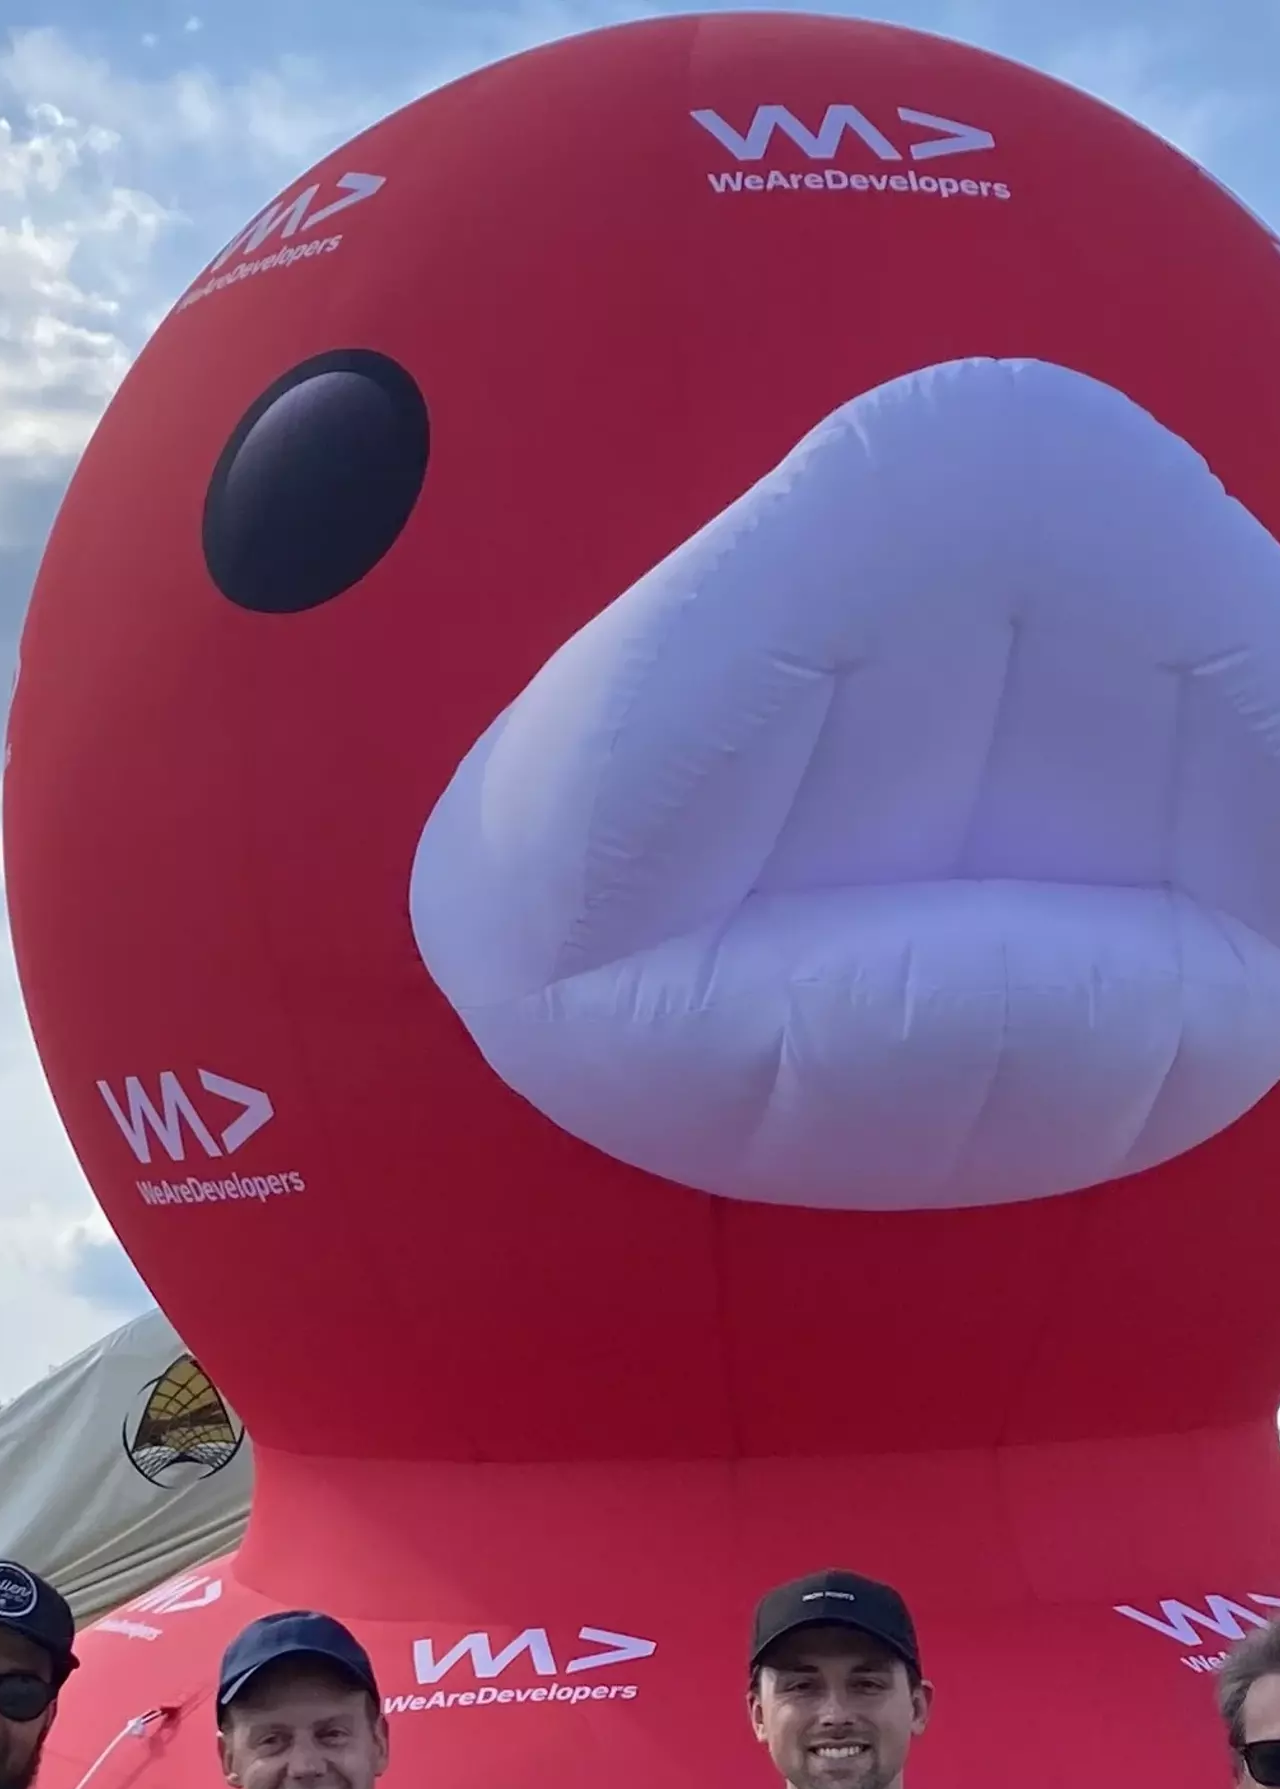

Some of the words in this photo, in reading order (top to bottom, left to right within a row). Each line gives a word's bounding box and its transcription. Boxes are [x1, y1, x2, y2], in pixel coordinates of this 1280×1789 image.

[707, 168, 1012, 200] WeAreDevelopers
[136, 1170, 306, 1206] WeAreDevelopers
[383, 1682, 638, 1714] WeAreDevelopers
